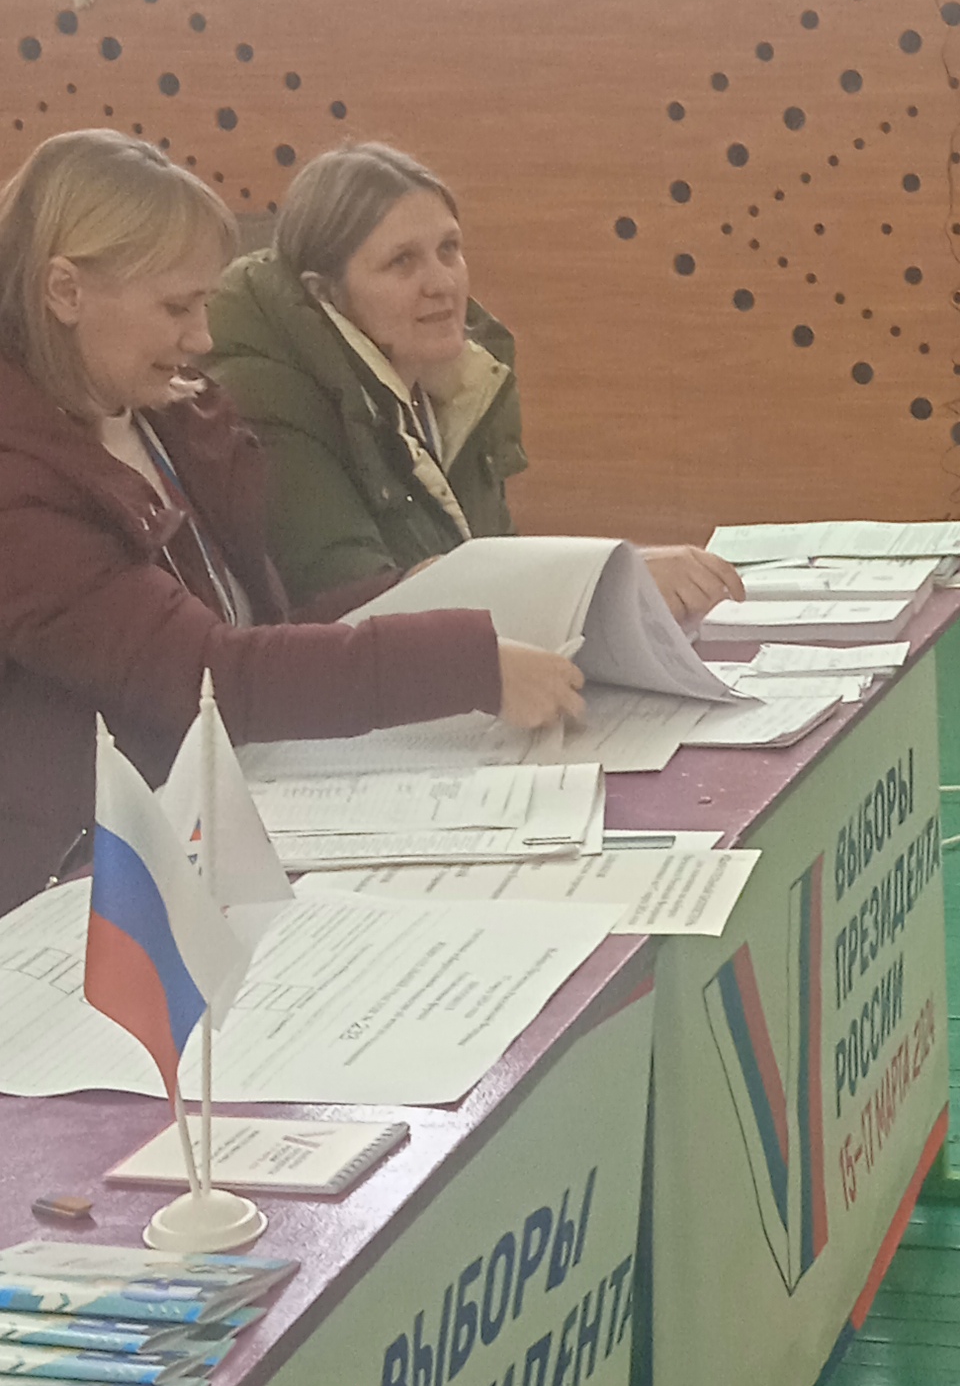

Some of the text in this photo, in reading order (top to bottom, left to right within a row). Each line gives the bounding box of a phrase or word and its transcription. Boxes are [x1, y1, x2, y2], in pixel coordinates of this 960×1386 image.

[835, 747, 913, 902] ВЫБОРЫ
[835, 815, 940, 1010] ПРЕЗИДЕНТА
[835, 951, 903, 1118] РОССИИ
[874, 1033, 911, 1152] МАРТА
